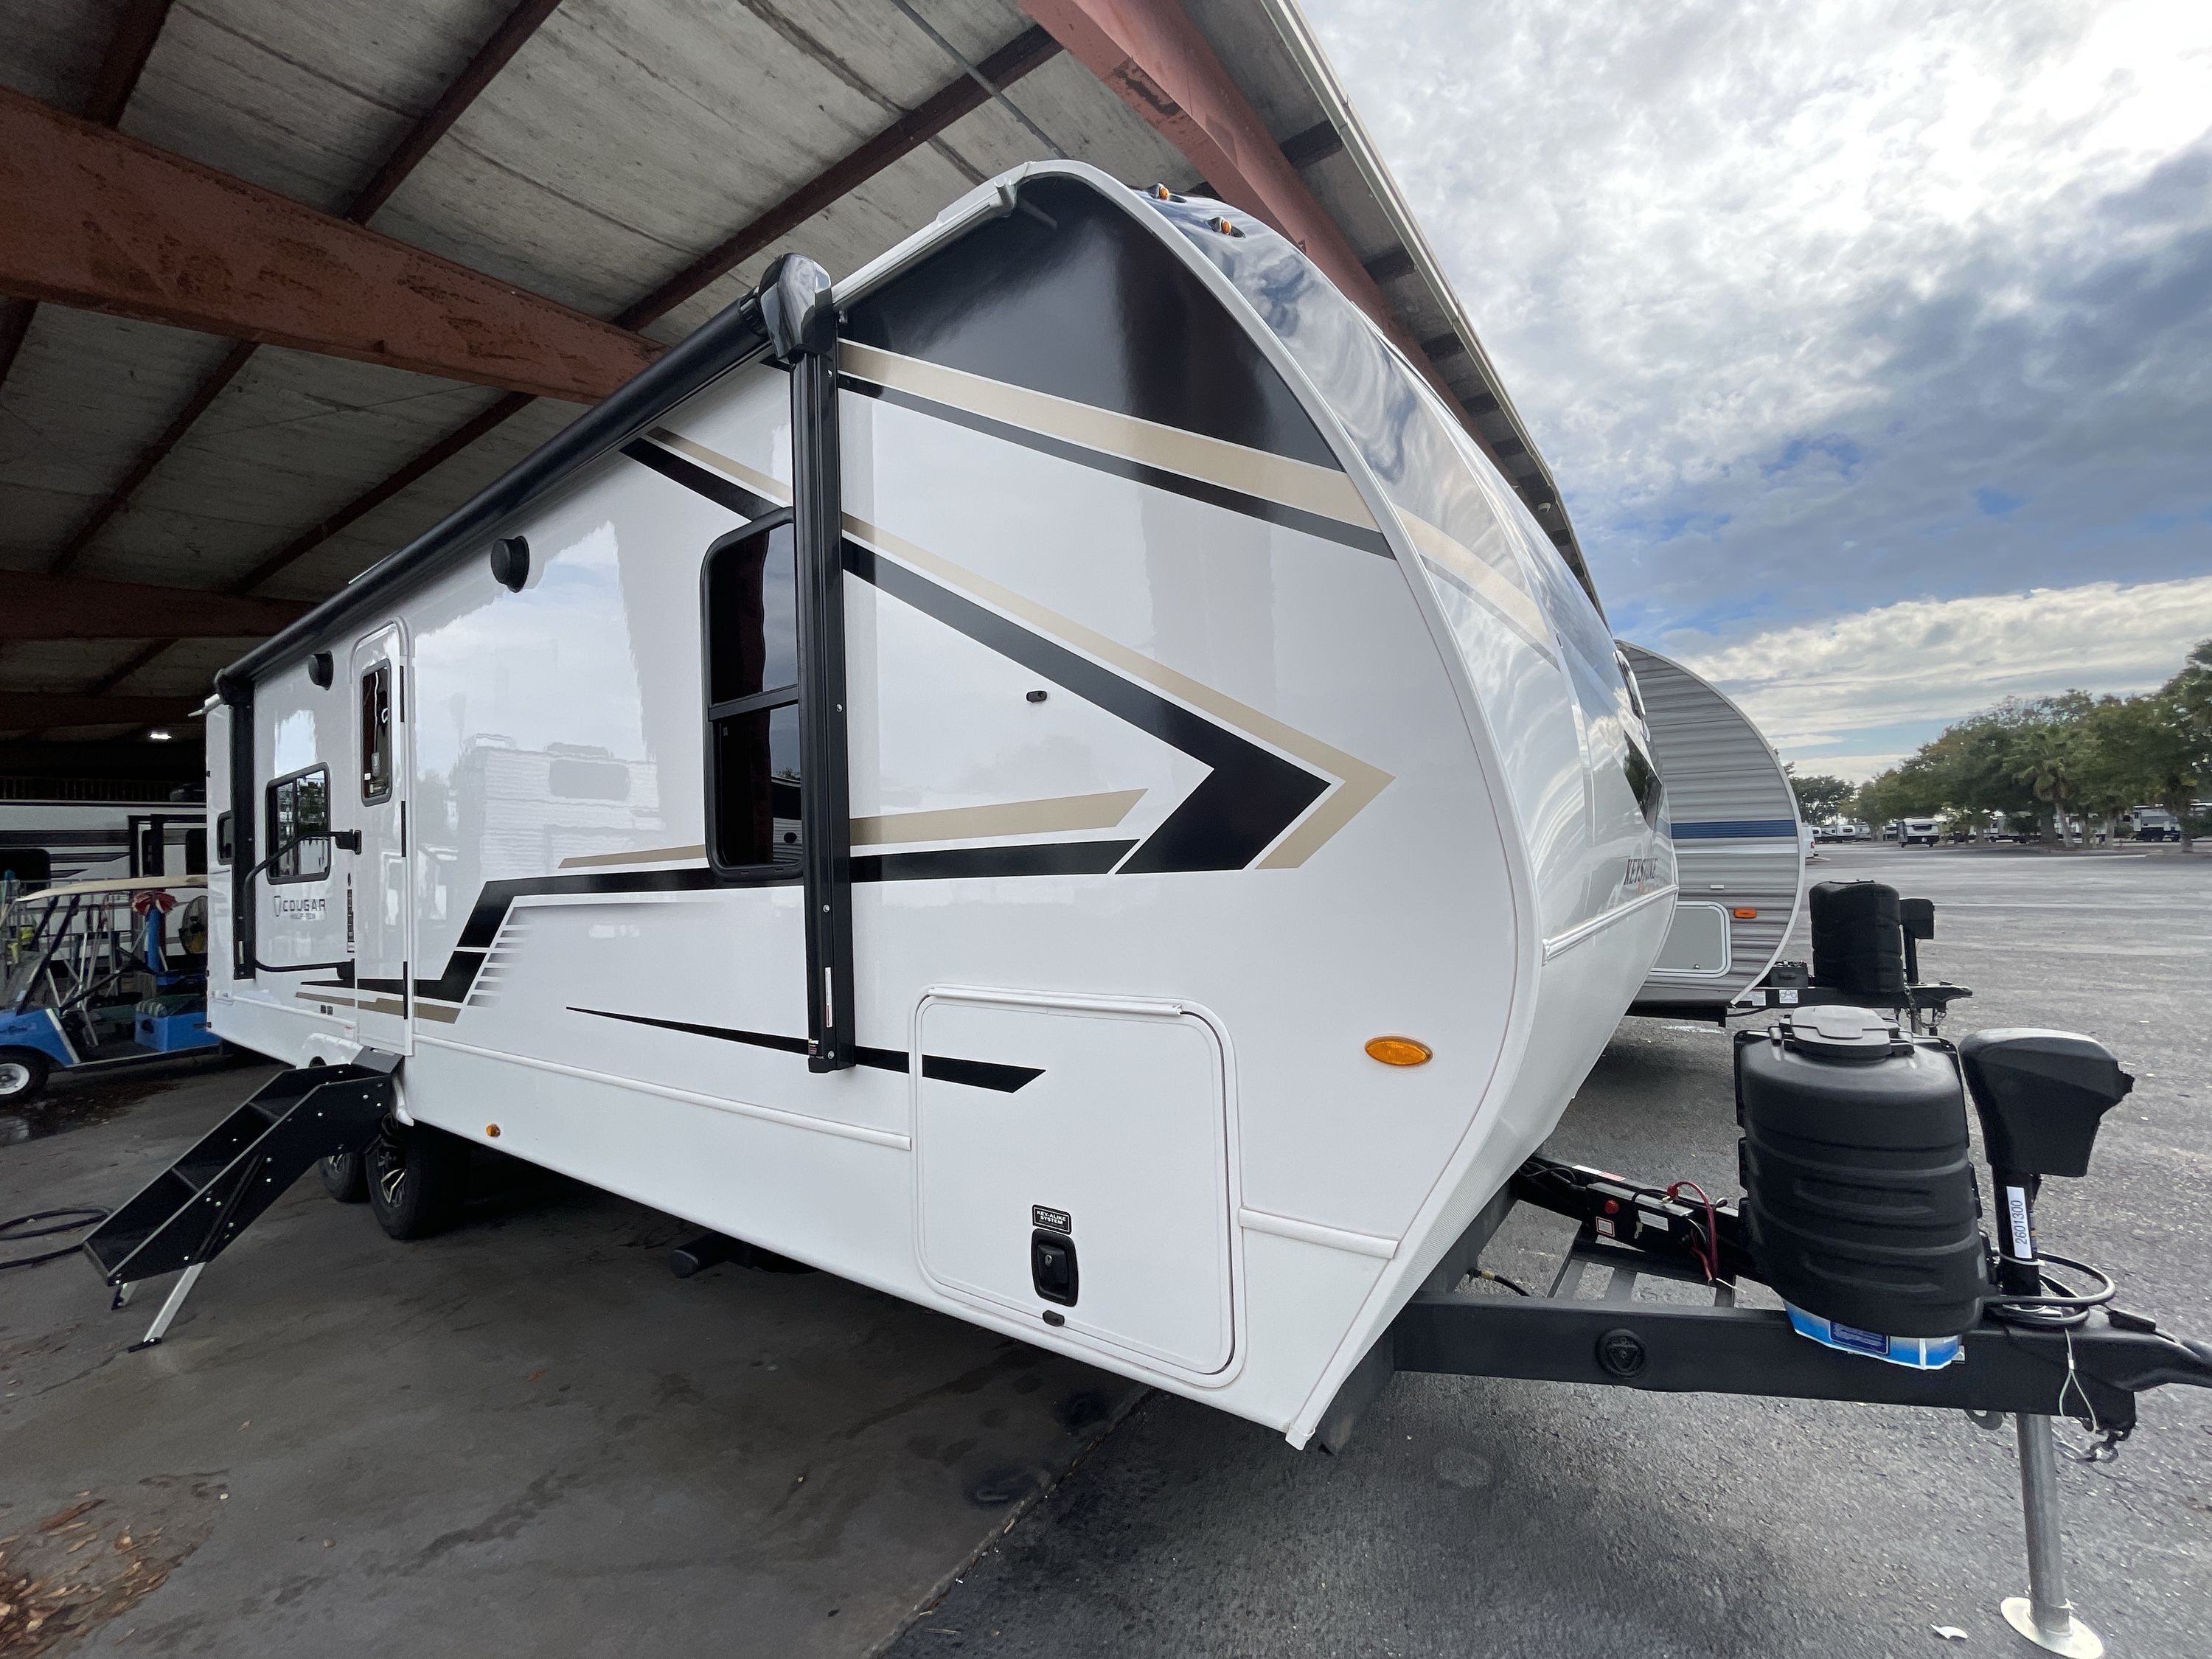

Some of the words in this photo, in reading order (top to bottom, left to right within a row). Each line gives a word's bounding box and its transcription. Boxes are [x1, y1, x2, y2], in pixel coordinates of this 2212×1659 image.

[283, 898, 326, 912] COUGAR
[1037, 1210, 1066, 1222] KEY-ALIKE
[1040, 1215, 1063, 1225] SYSTEM
[2010, 1200, 2028, 1245] 2601300
